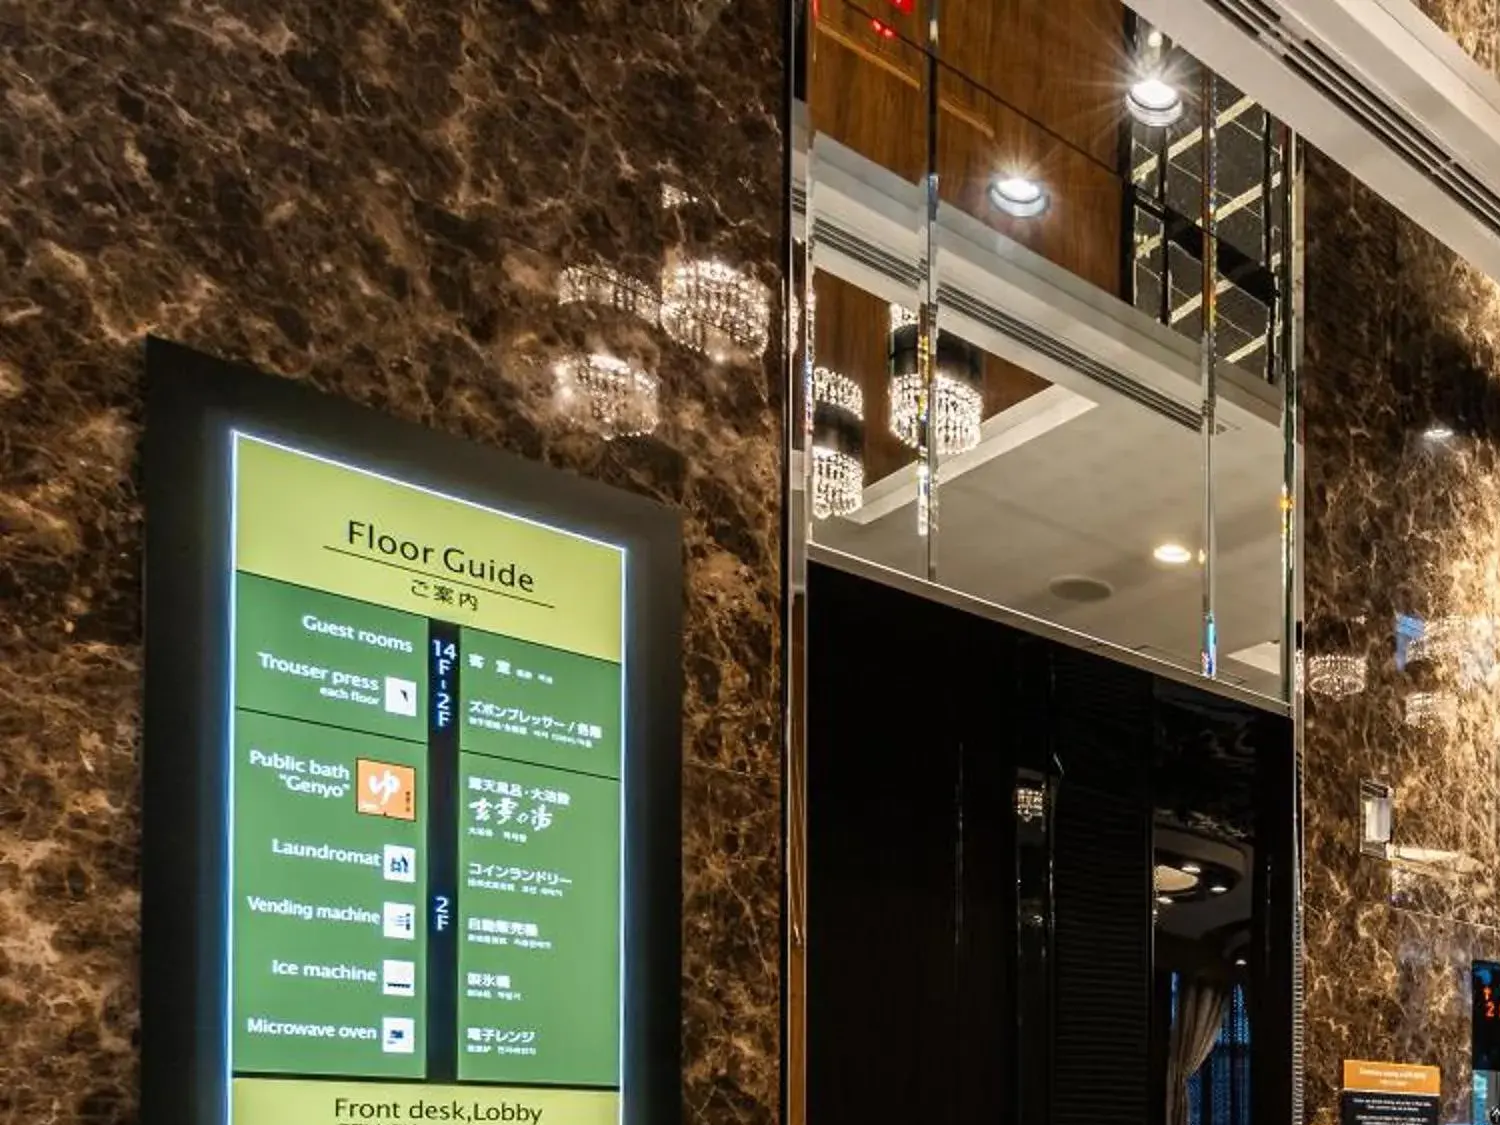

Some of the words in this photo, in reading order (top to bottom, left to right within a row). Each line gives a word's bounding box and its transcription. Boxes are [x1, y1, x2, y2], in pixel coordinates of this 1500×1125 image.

[348, 520, 435, 562] Floor
[442, 547, 535, 593] Guide
[410, 581, 479, 612] ご案内
[302, 615, 353, 640] Guest
[358, 628, 413, 654] rooms
[257, 651, 328, 680] Trouser
[333, 668, 379, 691] press
[319, 684, 348, 699] each
[351, 688, 380, 705] floor
[249, 749, 304, 777] Public
[308, 758, 350, 780] bath
[271, 838, 381, 867] Laundromat
[469, 862, 573, 885] コインランドリー
[247, 895, 312, 921] Vending
[316, 905, 381, 925] machine
[271, 958, 296, 979] Ice
[302, 962, 378, 983] machine
[246, 1017, 334, 1038] Microwave
[338, 1024, 378, 1040] oven
[335, 1098, 400, 1119] Front
